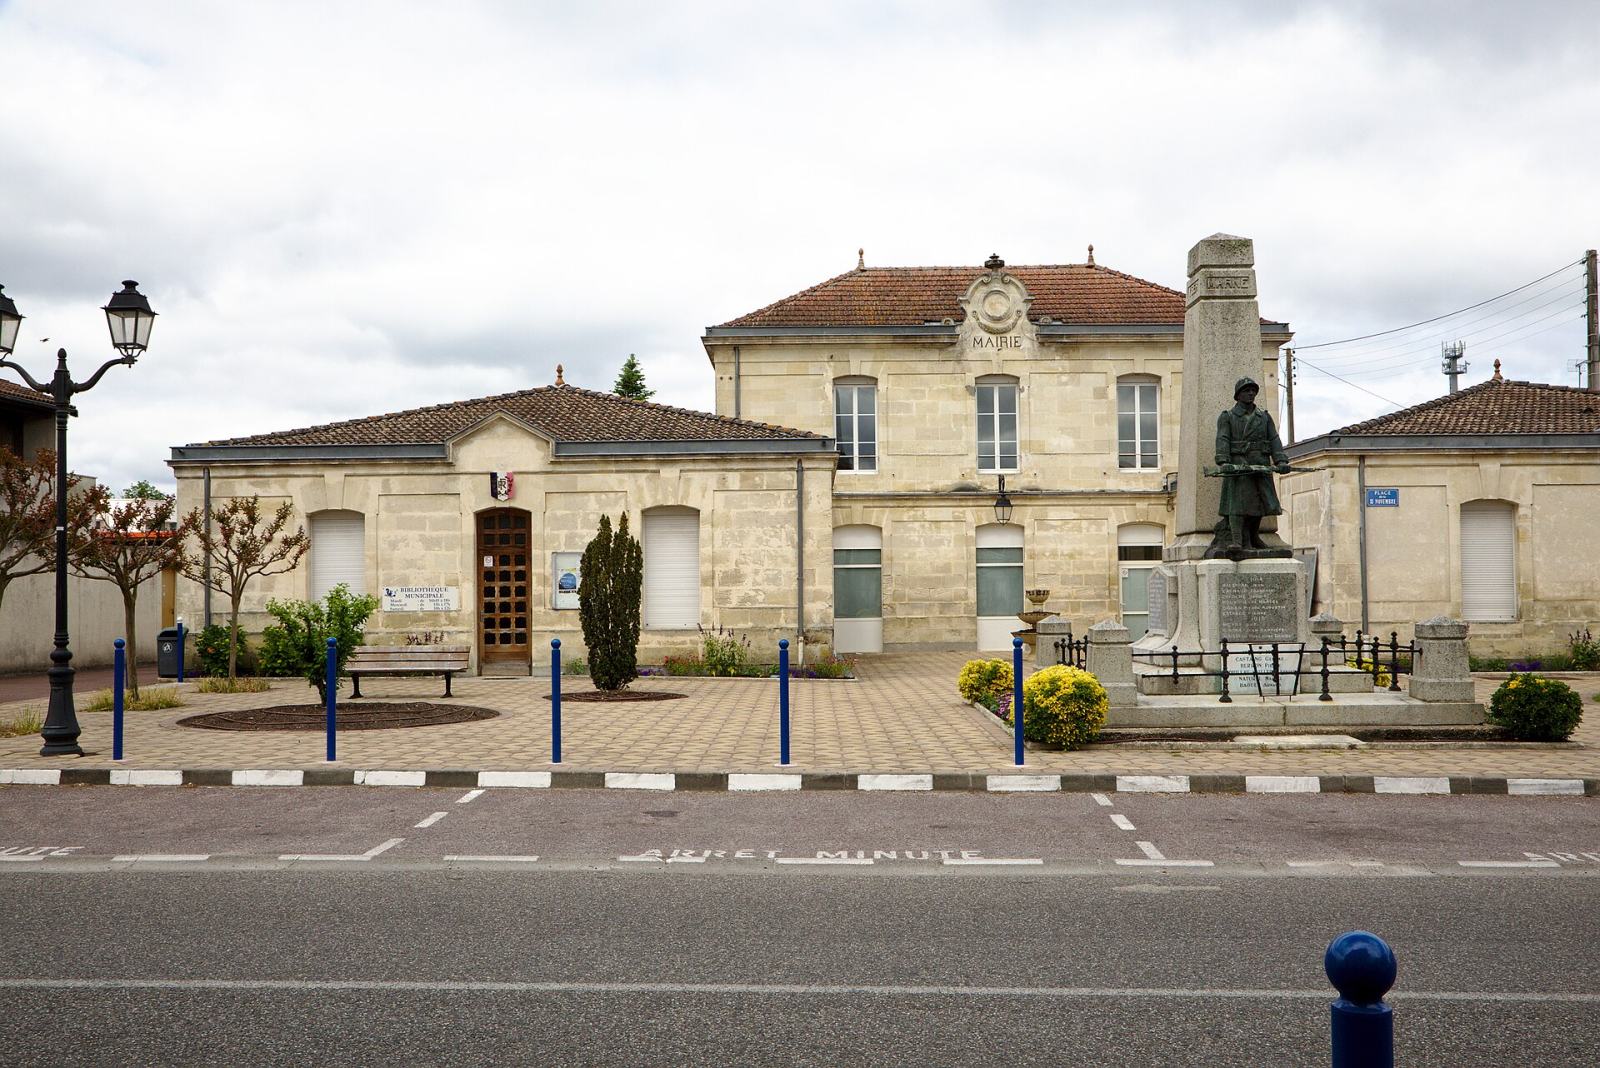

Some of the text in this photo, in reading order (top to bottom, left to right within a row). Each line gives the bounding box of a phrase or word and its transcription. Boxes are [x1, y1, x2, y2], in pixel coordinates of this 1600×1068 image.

[972, 336, 1022, 348] MAIRIE
[0, 846, 85, 856] UTE
[816, 850, 985, 860] MINUTE
